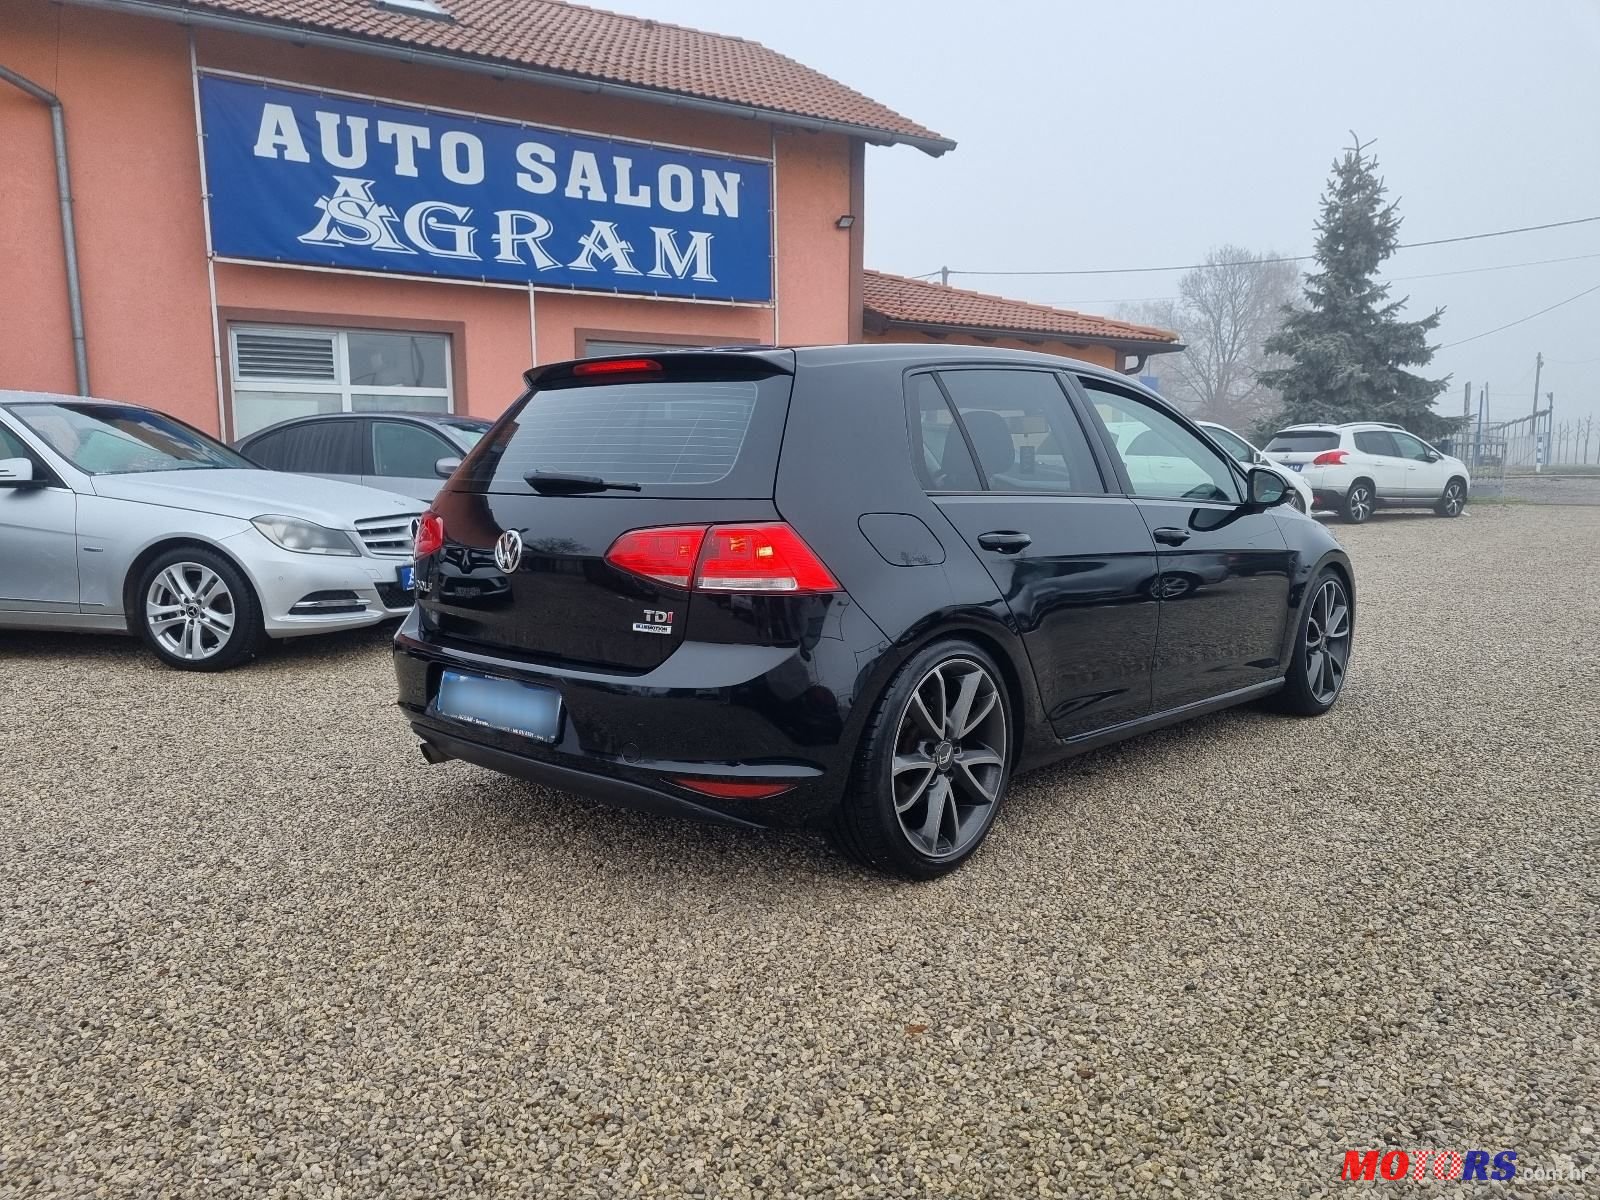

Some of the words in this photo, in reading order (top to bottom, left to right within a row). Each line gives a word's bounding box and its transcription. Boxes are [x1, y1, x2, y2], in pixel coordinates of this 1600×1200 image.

[253, 103, 485, 186] AUTO
[515, 141, 742, 219] SALON
[643, 609, 674, 624] TDI
